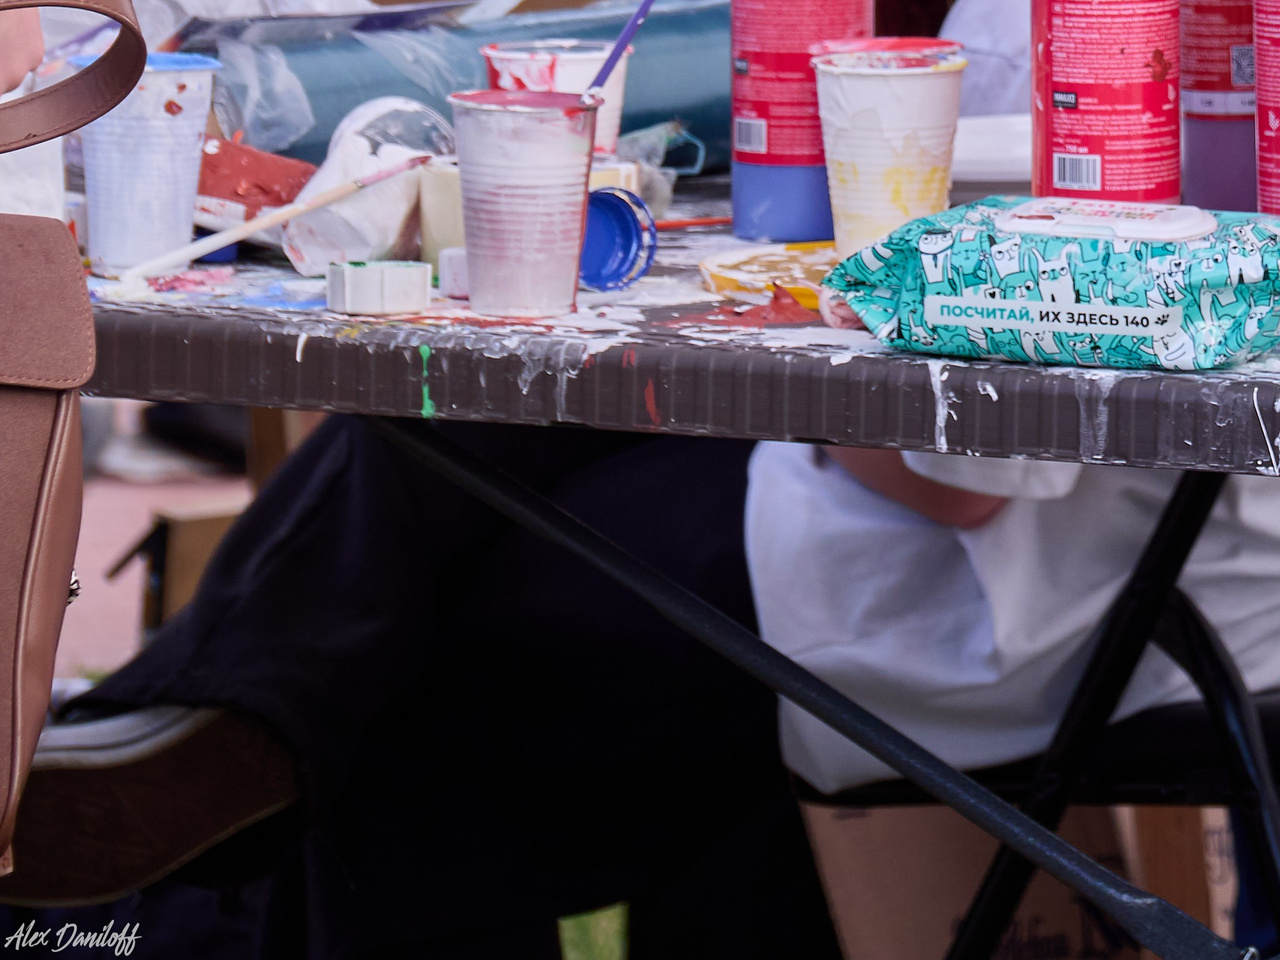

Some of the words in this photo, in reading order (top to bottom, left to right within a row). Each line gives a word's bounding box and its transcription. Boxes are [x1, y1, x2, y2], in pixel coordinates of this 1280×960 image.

[939, 304, 1035, 324] ПОСЧИТАЙ,
[1039, 310, 1061, 323] ИХ
[1066, 312, 1119, 327] ЗДЕСЬ
[1124, 315, 1150, 328] 140
